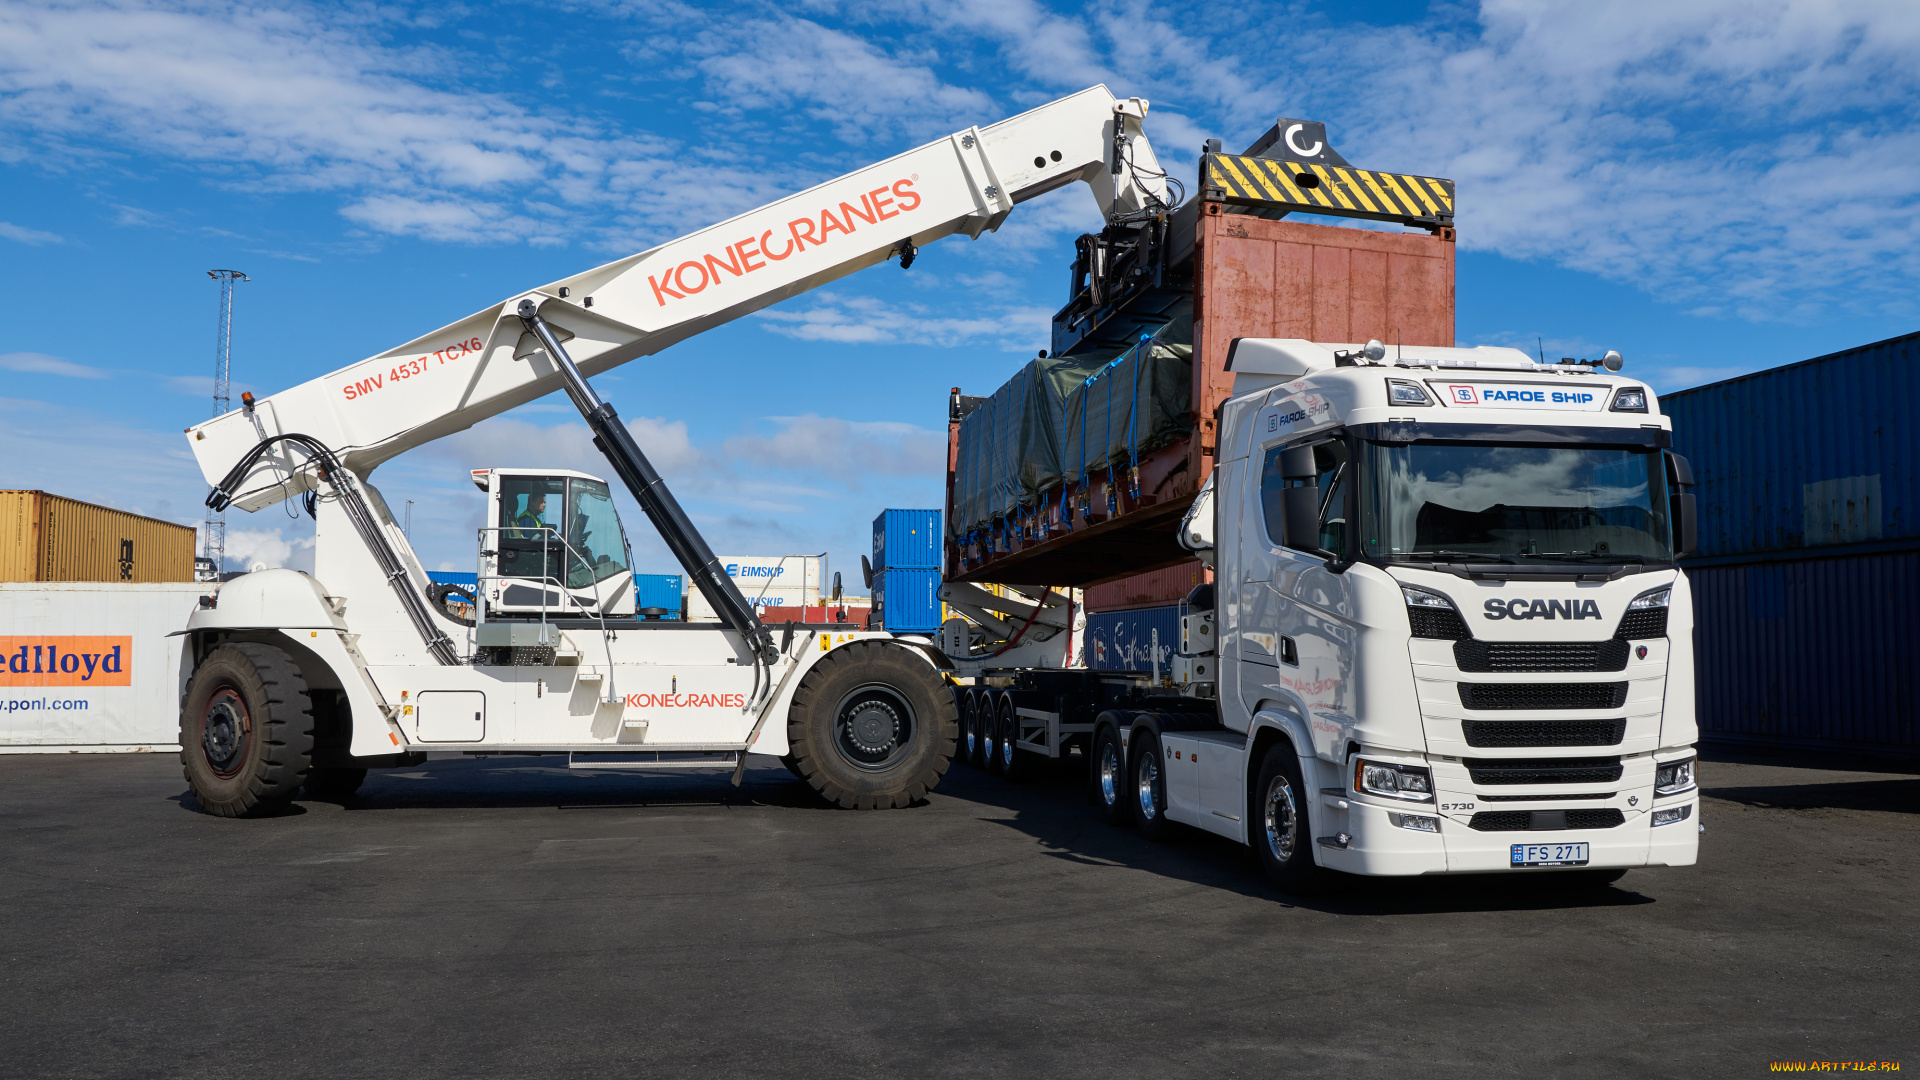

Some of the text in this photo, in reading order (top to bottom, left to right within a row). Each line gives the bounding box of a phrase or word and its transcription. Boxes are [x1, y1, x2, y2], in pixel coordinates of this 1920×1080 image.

[648, 179, 921, 307] KONECRANES
[343, 337, 483, 400] SMV 4537 TCX6
[1483, 390, 1593, 403] FAROE SHIP
[1280, 402, 1330, 427] FAROE SHIP
[741, 566, 784, 577] EIMSKIP
[745, 597, 784, 607] IMSKIP
[1483, 598, 1603, 620] SCANIA
[0, 697, 89, 714] .ponl.com
[626, 693, 745, 708] KONECRANES
[1451, 802, 1475, 810] 730
[1528, 846, 1549, 860] FS
[1555, 845, 1581, 860] 271
